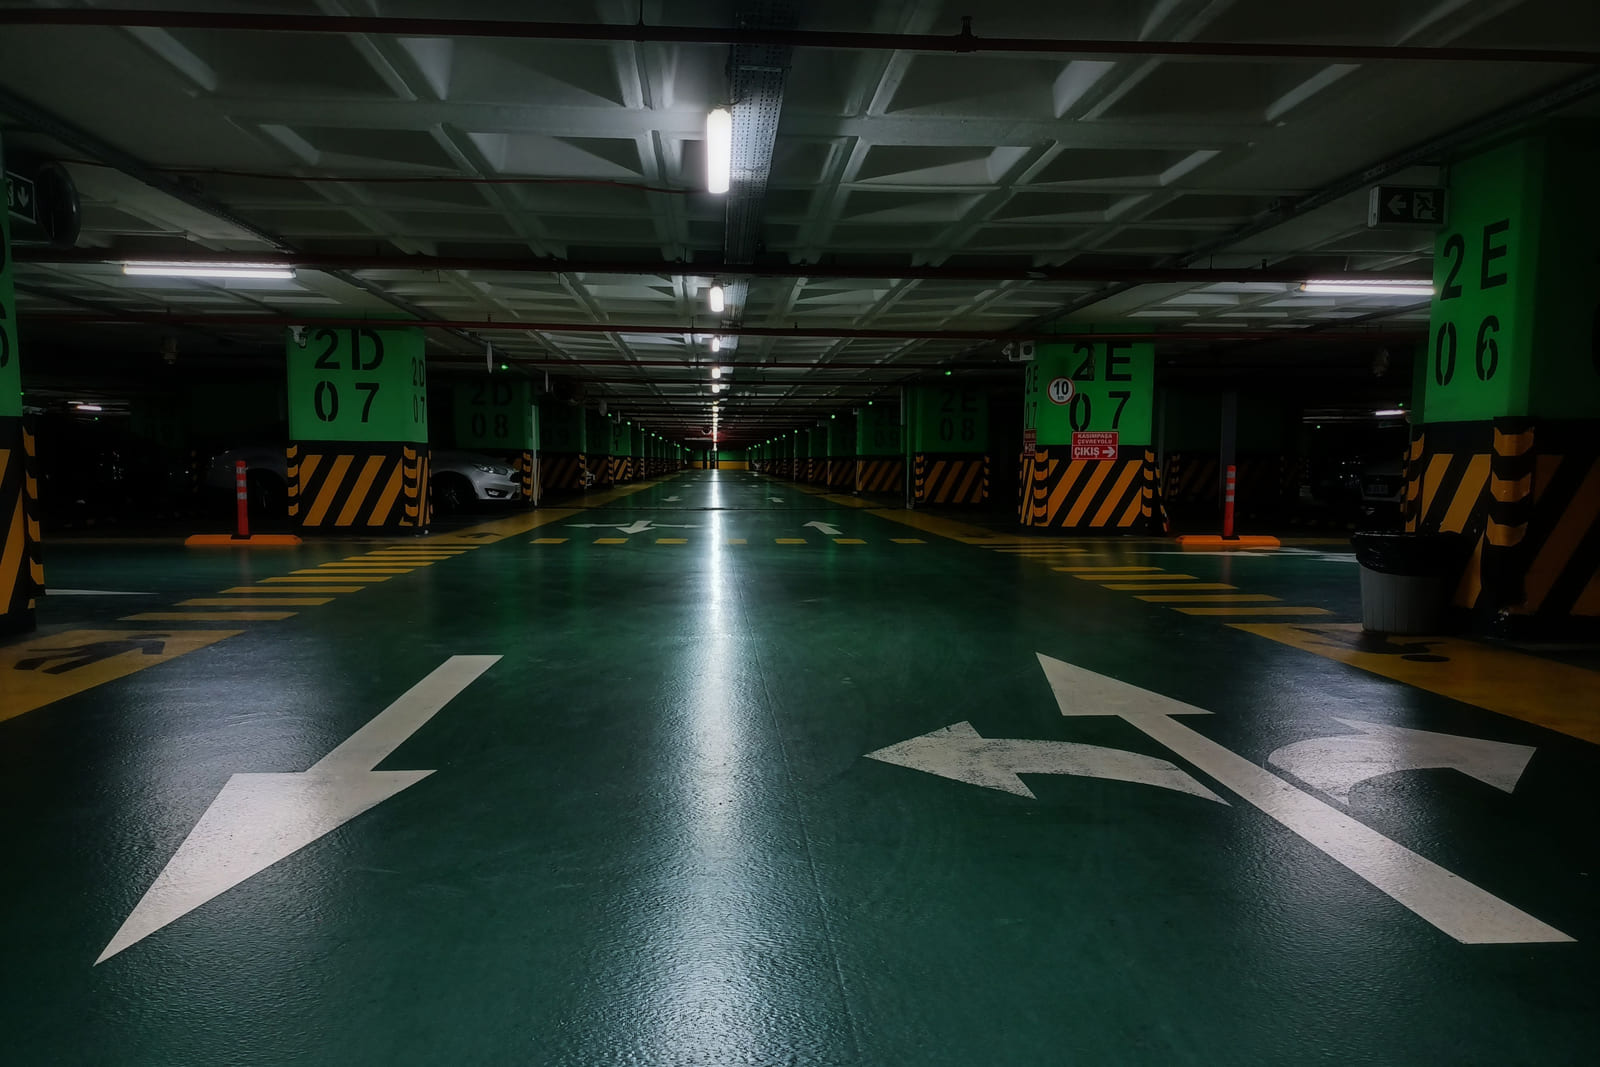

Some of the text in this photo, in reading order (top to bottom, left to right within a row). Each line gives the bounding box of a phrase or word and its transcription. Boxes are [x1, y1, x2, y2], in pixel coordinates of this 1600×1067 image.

[1440, 218, 1509, 300] 2E
[315, 328, 384, 371] 2D
[1071, 342, 1132, 381] 2E
[1435, 315, 1499, 386] 06
[315, 381, 380, 423] 07
[1053, 381, 1069, 396] 10
[471, 413, 509, 438] 08
[940, 417, 976, 442] 08
[1069, 391, 1131, 432] 07
[1074, 446, 1101, 459] ÇIKIŞ
